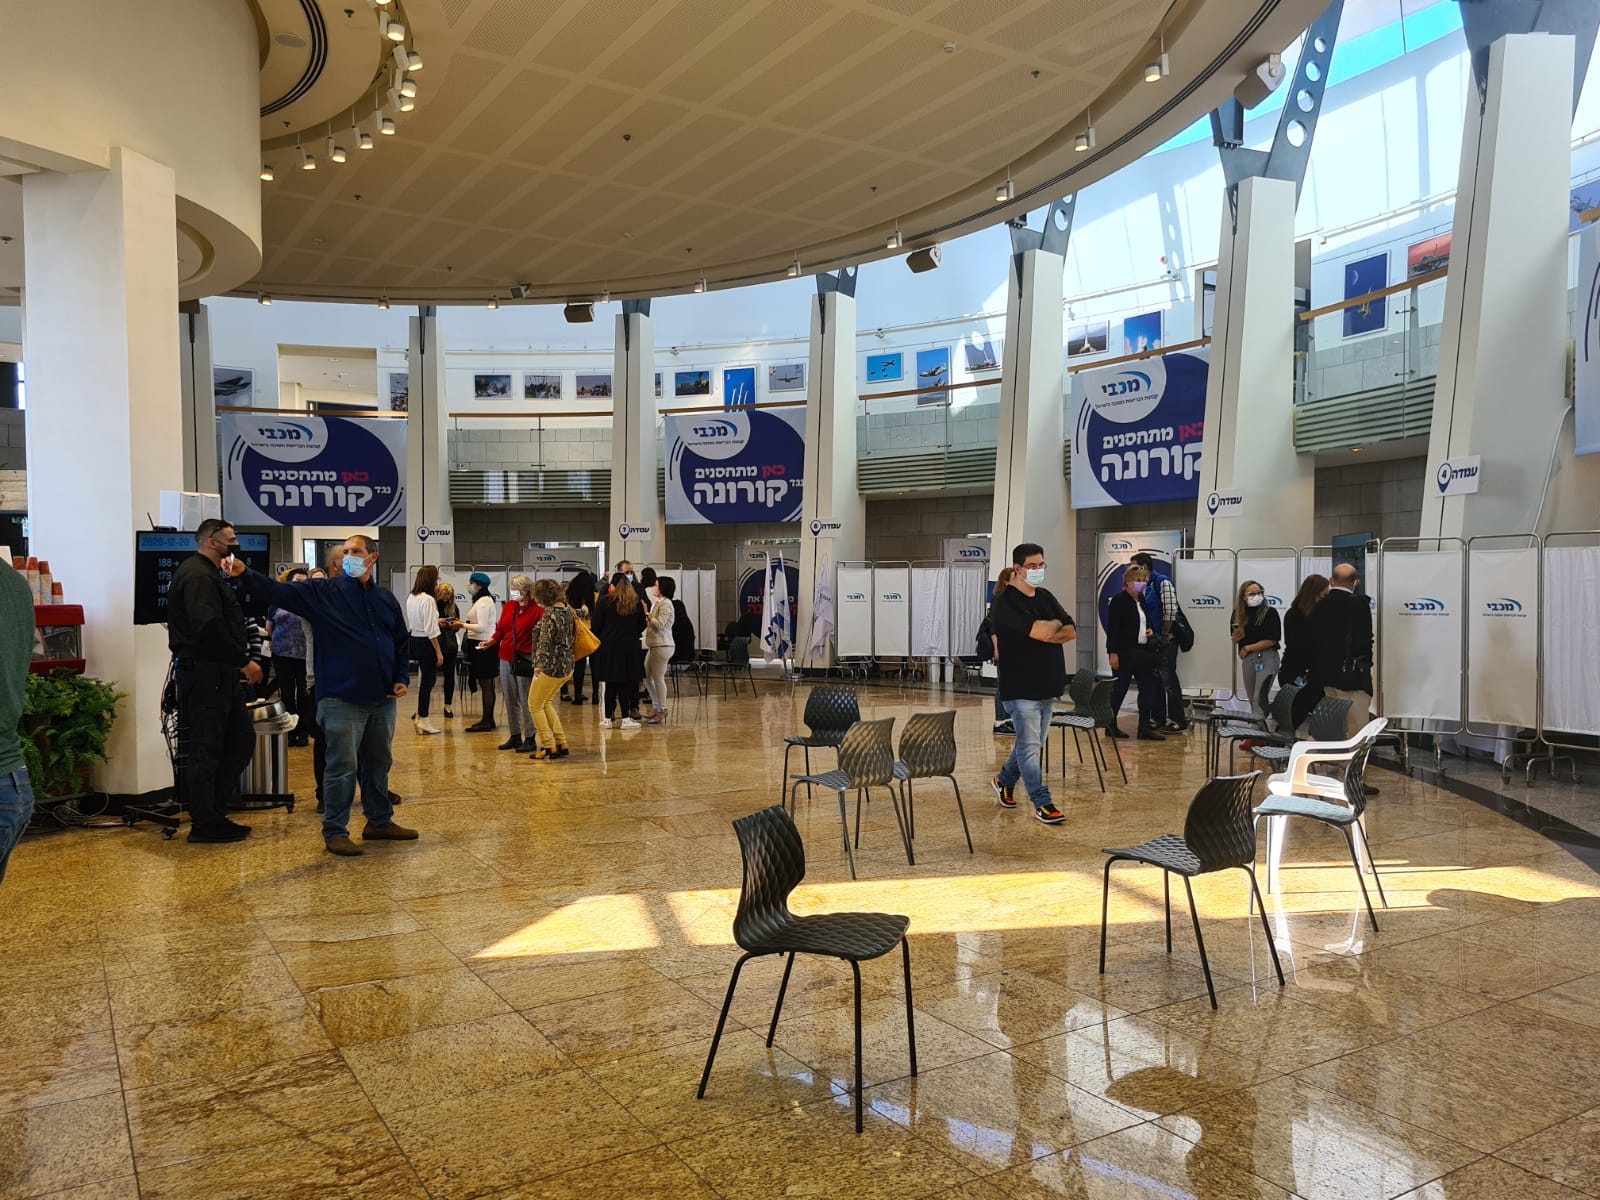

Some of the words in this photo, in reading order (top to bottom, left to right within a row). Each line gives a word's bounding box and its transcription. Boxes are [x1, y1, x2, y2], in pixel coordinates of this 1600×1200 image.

[1101, 378, 1140, 397] מכבי
[258, 428, 302, 440] מכבי
[693, 425, 728, 438] מכבי
[1102, 427, 1174, 450] מתחסנים
[260, 469, 337, 482] מתחסנים
[341, 471, 369, 484] כאן
[695, 465, 758, 479] מתחסנים
[761, 464, 786, 479] כאן
[1441, 469, 1447, 479] 4
[1451, 466, 1478, 480] עמדה
[374, 486, 392, 495] נגד
[693, 479, 789, 508] קורונה
[259, 484, 373, 513] קורונה
[1211, 497, 1216, 505] 5
[1220, 495, 1242, 506] עמדה
[158, 558, 172, 567] 188
[158, 571, 172, 580] 179
[1404, 602, 1436, 611] מכבי
[1486, 603, 1514, 611] מכבי
